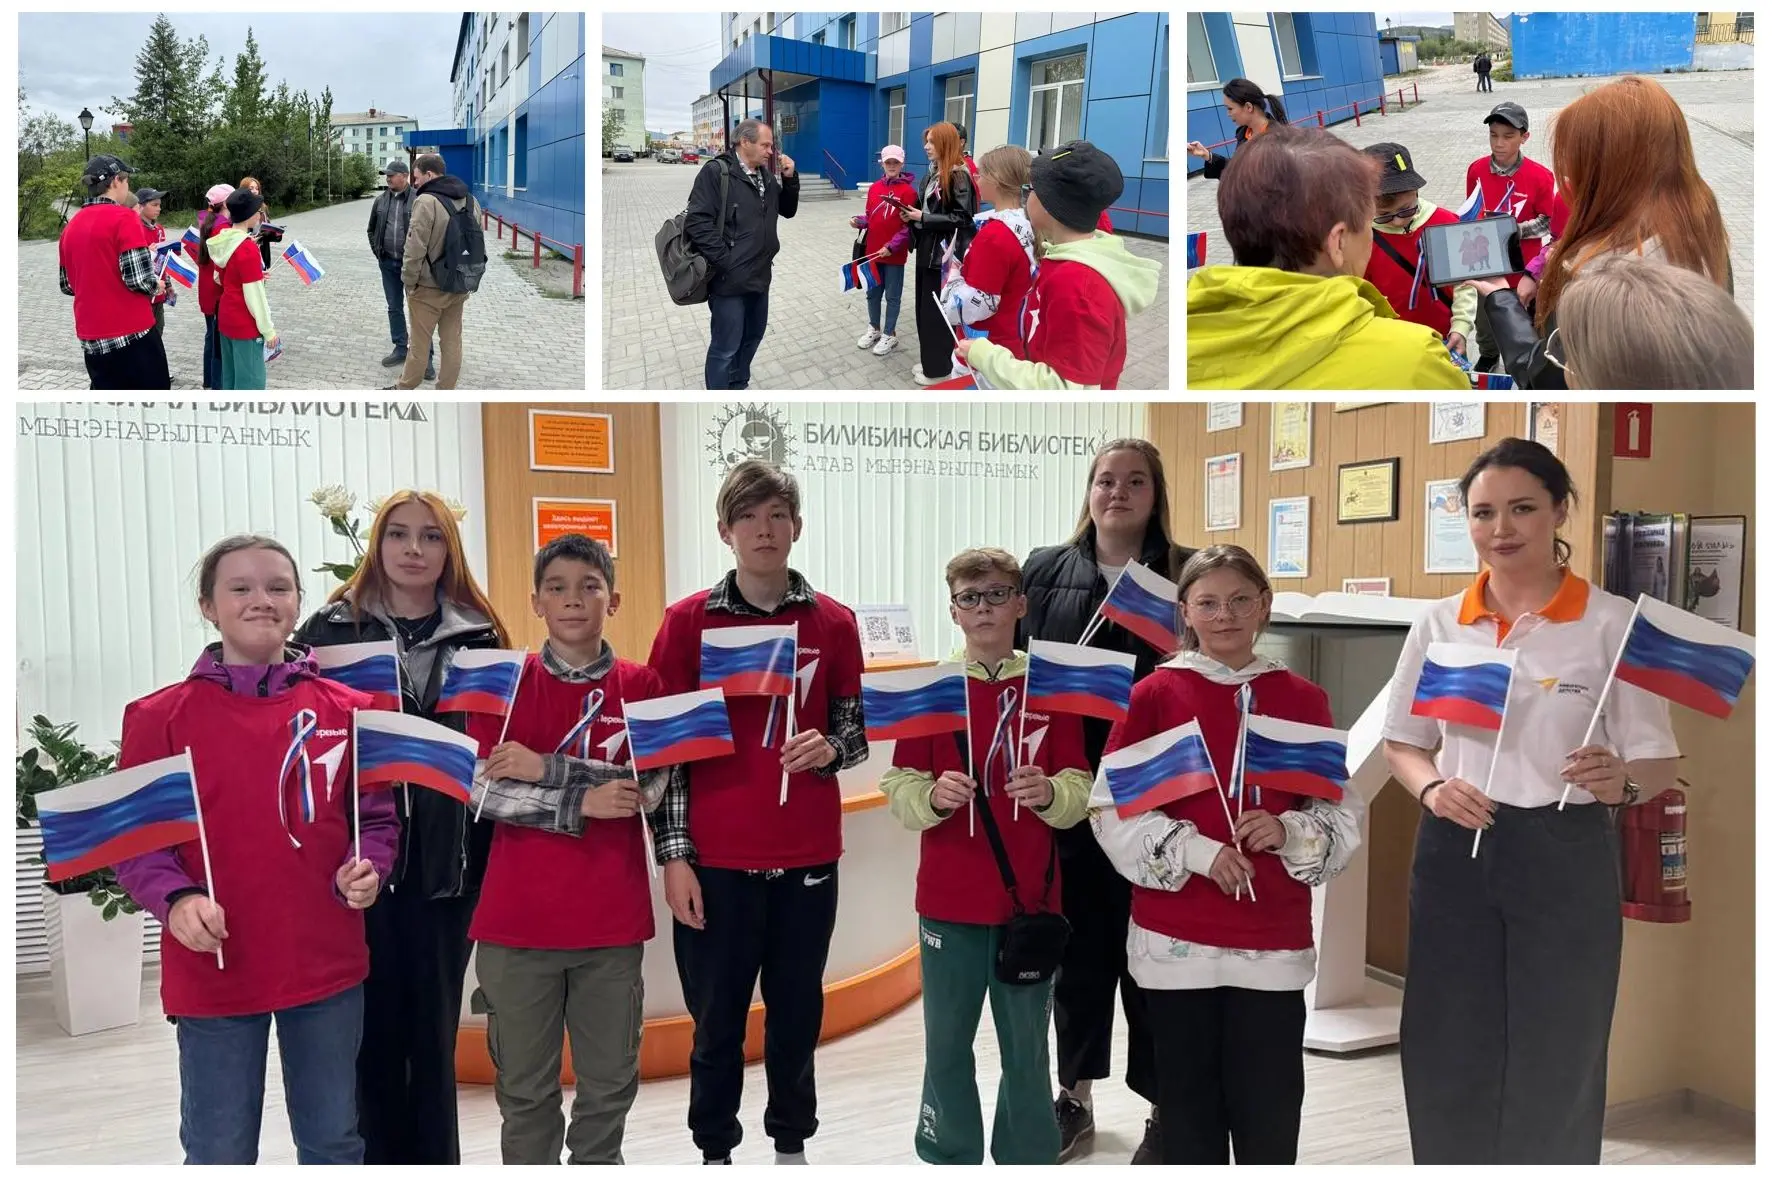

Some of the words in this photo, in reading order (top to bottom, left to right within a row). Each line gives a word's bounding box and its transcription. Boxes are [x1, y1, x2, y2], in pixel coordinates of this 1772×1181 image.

[804, 422, 971, 451] БИЛИБИНСКАЯ
[978, 430, 1106, 456] БИБЛИОТЕК
[802, 454, 855, 473] АТАВ
[315, 728, 348, 738] рвые
